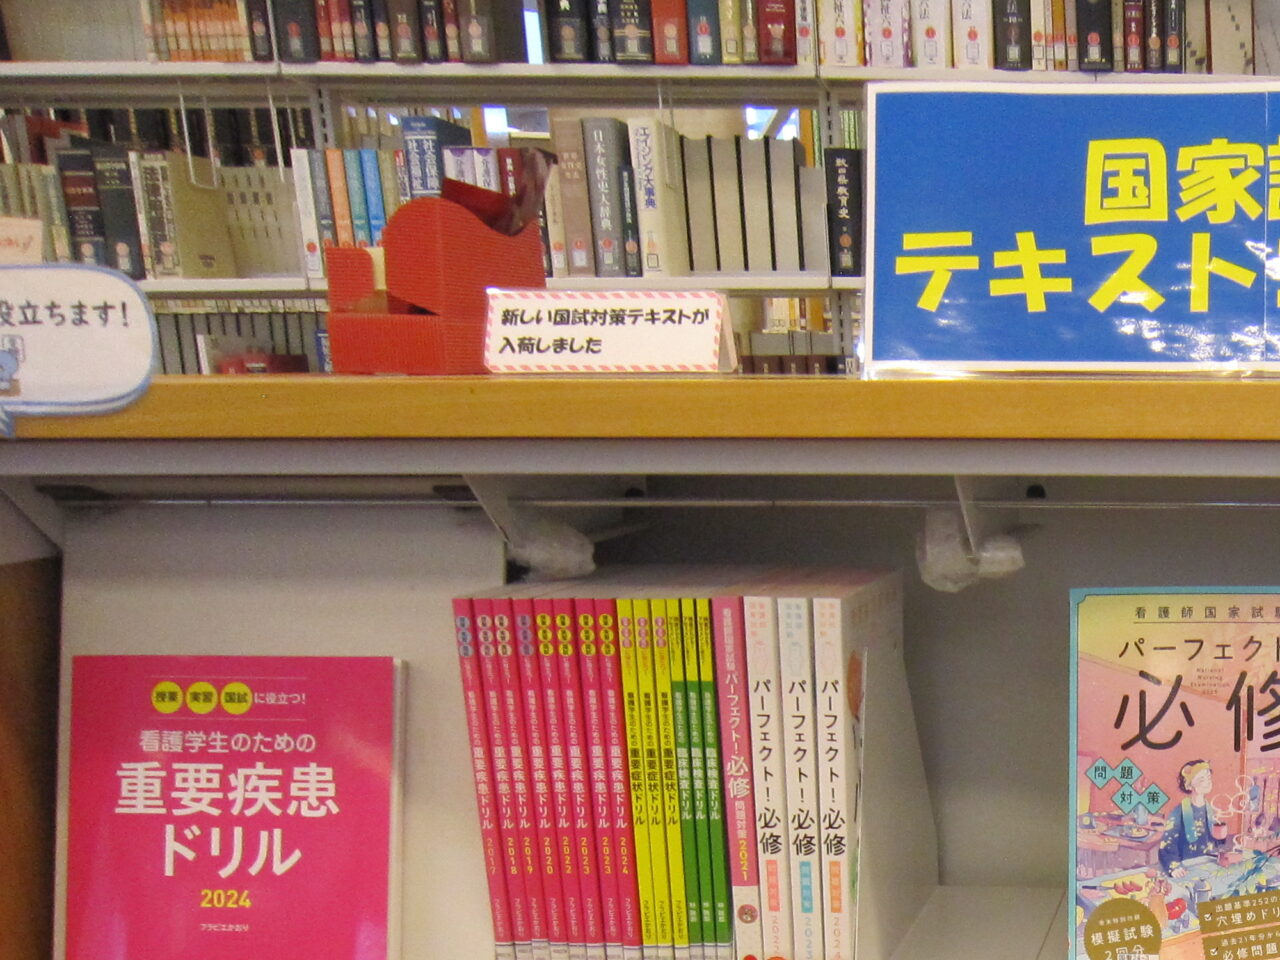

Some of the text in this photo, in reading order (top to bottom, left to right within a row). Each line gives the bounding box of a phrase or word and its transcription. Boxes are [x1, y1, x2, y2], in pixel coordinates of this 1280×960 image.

[501, 308, 710, 326] 新しい国試対策テキストが
[498, 337, 602, 355] 入荷しました
[139, 730, 316, 753] 看護学生のための
[114, 761, 340, 818] 重要疾患
[511, 745, 531, 829] 重要疾患ドリル
[533, 745, 551, 829] 重要疾患ドリル
[569, 745, 588, 829] 重要疾患ドリル
[610, 745, 628, 829] 重要疾患ドリル
[1093, 765, 1134, 780] 問題
[727, 756, 750, 798] 必修
[739, 840, 748, 880] 2021
[1120, 791, 1160, 806] 対策
[164, 824, 302, 878] ドリル
[758, 807, 782, 855] 必修
[791, 808, 816, 856] 必修
[822, 808, 846, 856] 必修
[200, 889, 251, 908] 2024
[1091, 925, 1155, 946] 模擬試験
